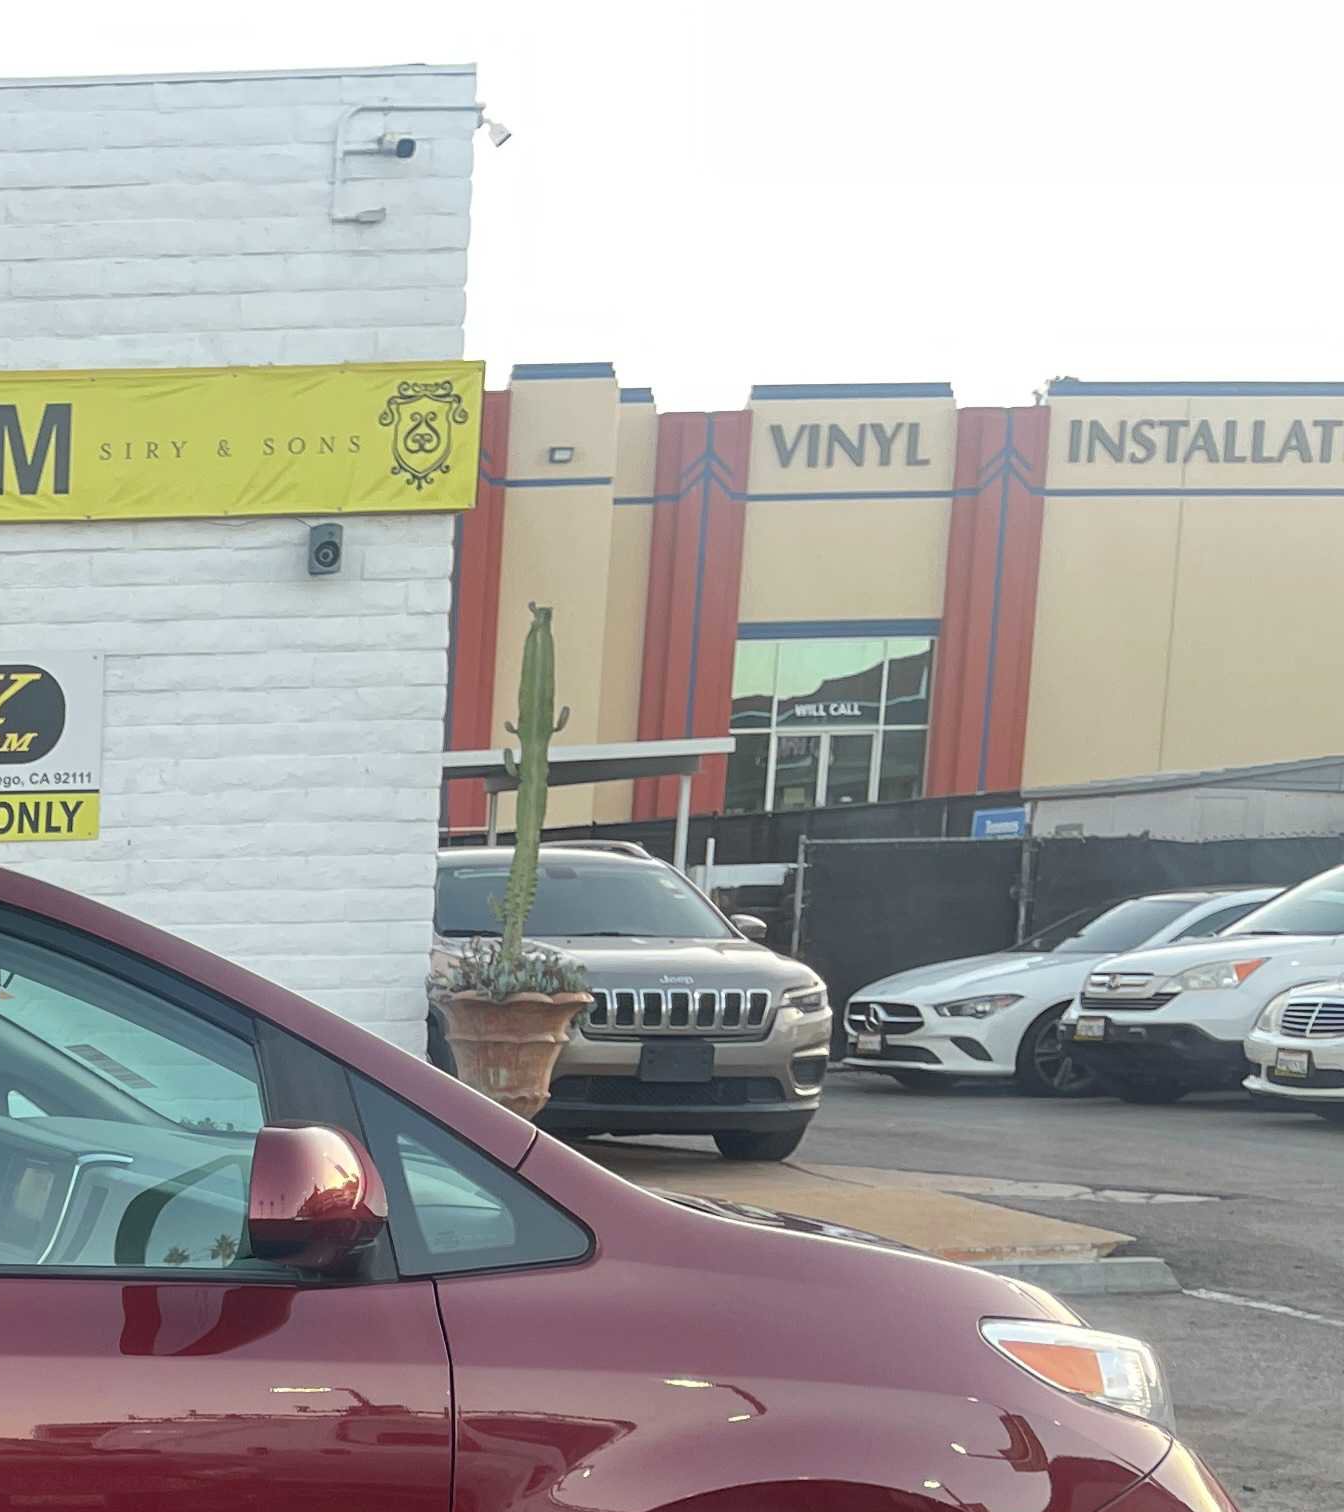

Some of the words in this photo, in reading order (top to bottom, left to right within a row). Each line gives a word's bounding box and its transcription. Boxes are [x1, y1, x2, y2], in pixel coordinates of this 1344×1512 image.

[99, 440, 187, 460] SIRY
[217, 440, 232, 457] &
[263, 435, 361, 455] SONS
[769, 421, 931, 468] VINYL
[1067, 418, 1344, 464] INSTALLAT
[794, 703, 827, 717] WILL
[829, 702, 862, 716] CALL
[29, 771, 50, 786] CA
[54, 771, 92, 785] 92111
